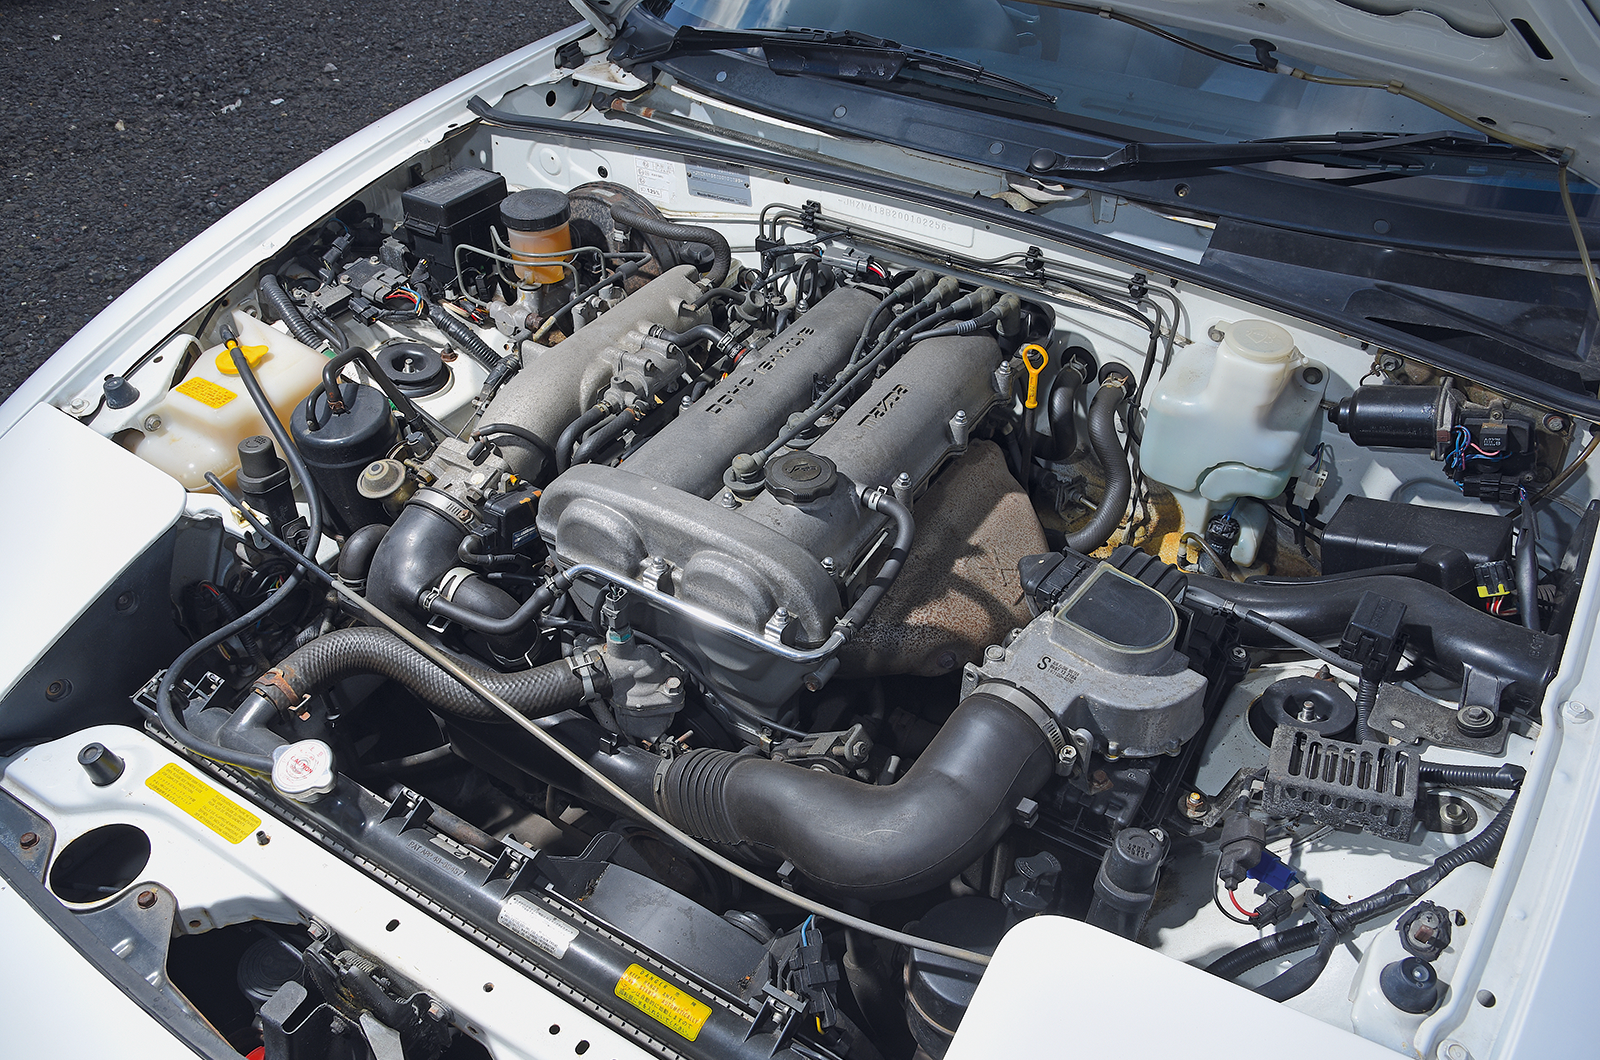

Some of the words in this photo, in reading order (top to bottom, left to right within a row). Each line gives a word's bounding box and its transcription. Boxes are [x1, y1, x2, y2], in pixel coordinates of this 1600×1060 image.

[705, 376, 754, 414] DOHC
[290, 755, 313, 774] CAUTION
[407, 840, 422, 852] PAT
[629, 971, 641, 980] KEEP
[643, 980, 659, 992] HANDS
[639, 970, 668, 989] DANGER
[639, 984, 657, 999] STARTS
[661, 999, 700, 1024] AUTOMATICALLY
